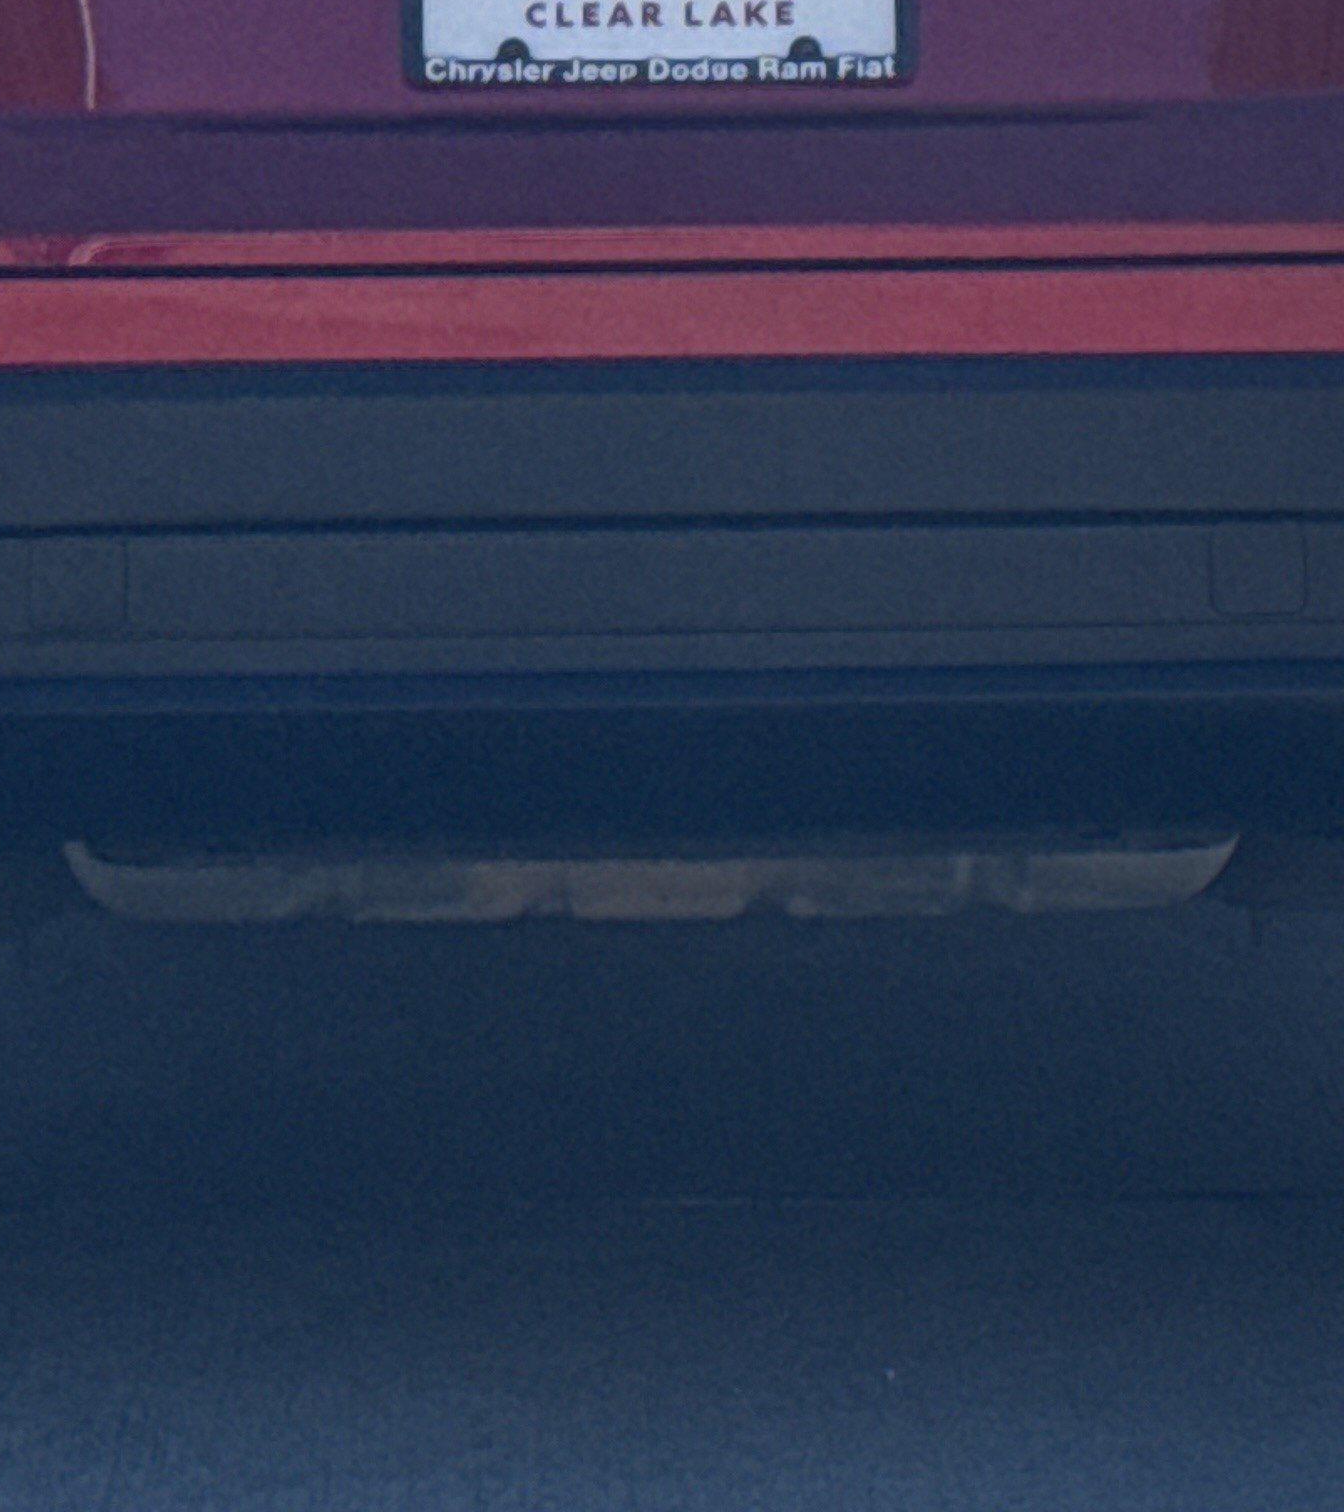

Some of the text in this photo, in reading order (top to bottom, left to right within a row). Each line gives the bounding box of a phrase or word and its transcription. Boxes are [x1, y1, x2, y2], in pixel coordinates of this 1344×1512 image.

[525, 0, 796, 28] CLEAR LAKE
[425, 54, 897, 84] Chrysler Jeep Dodge Ram Fiat
